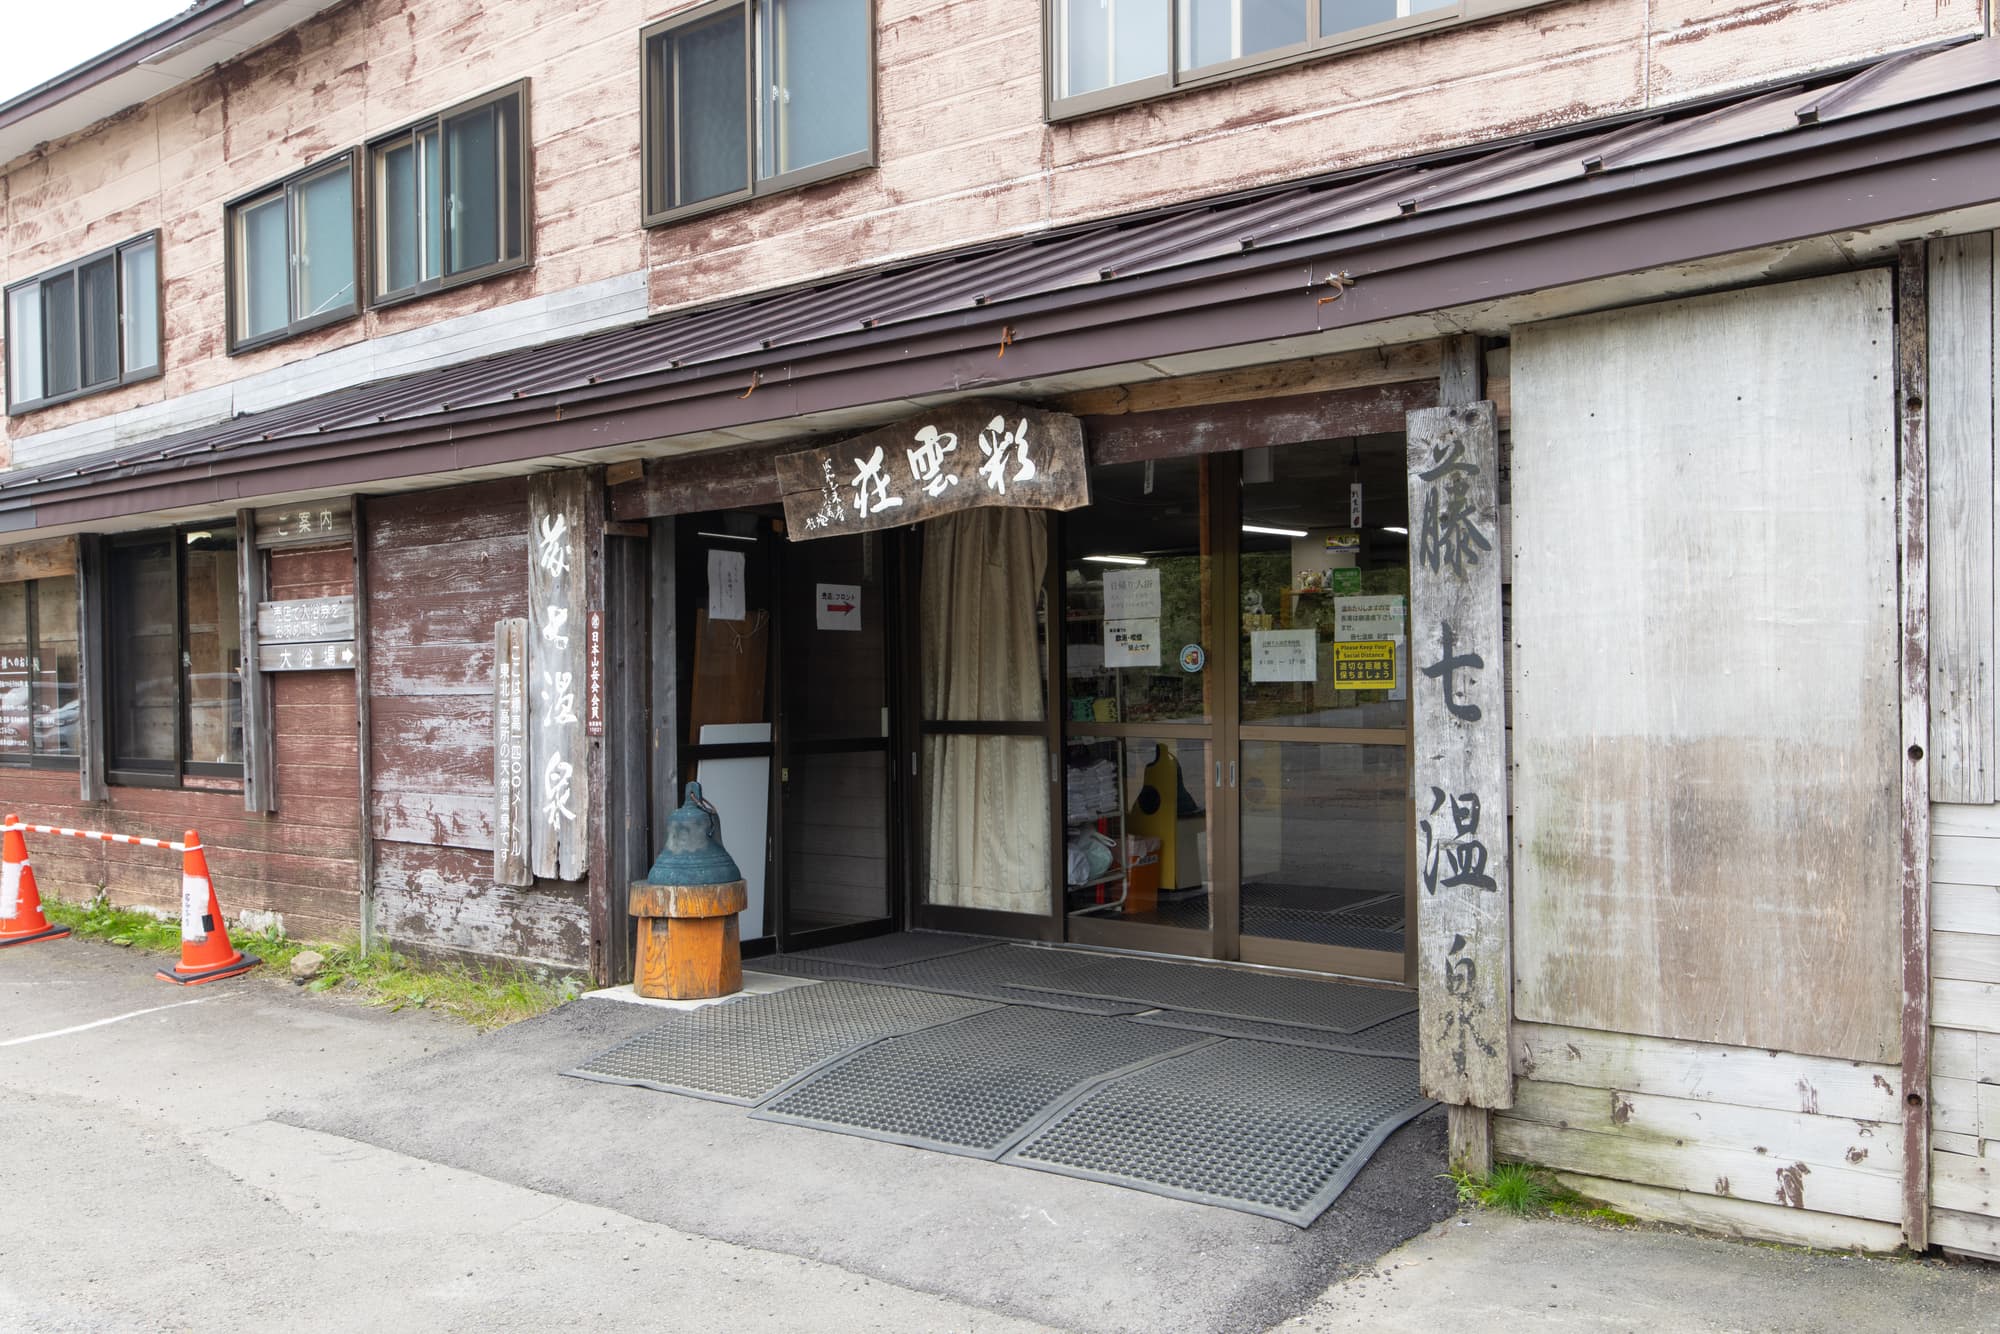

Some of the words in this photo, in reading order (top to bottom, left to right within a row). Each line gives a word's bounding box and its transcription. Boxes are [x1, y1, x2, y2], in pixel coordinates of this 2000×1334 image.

[279, 645, 336, 669] 大浴場
[1339, 661, 1390, 671] 適切な距離を
[1339, 670, 1390, 680] 保ちましょう
